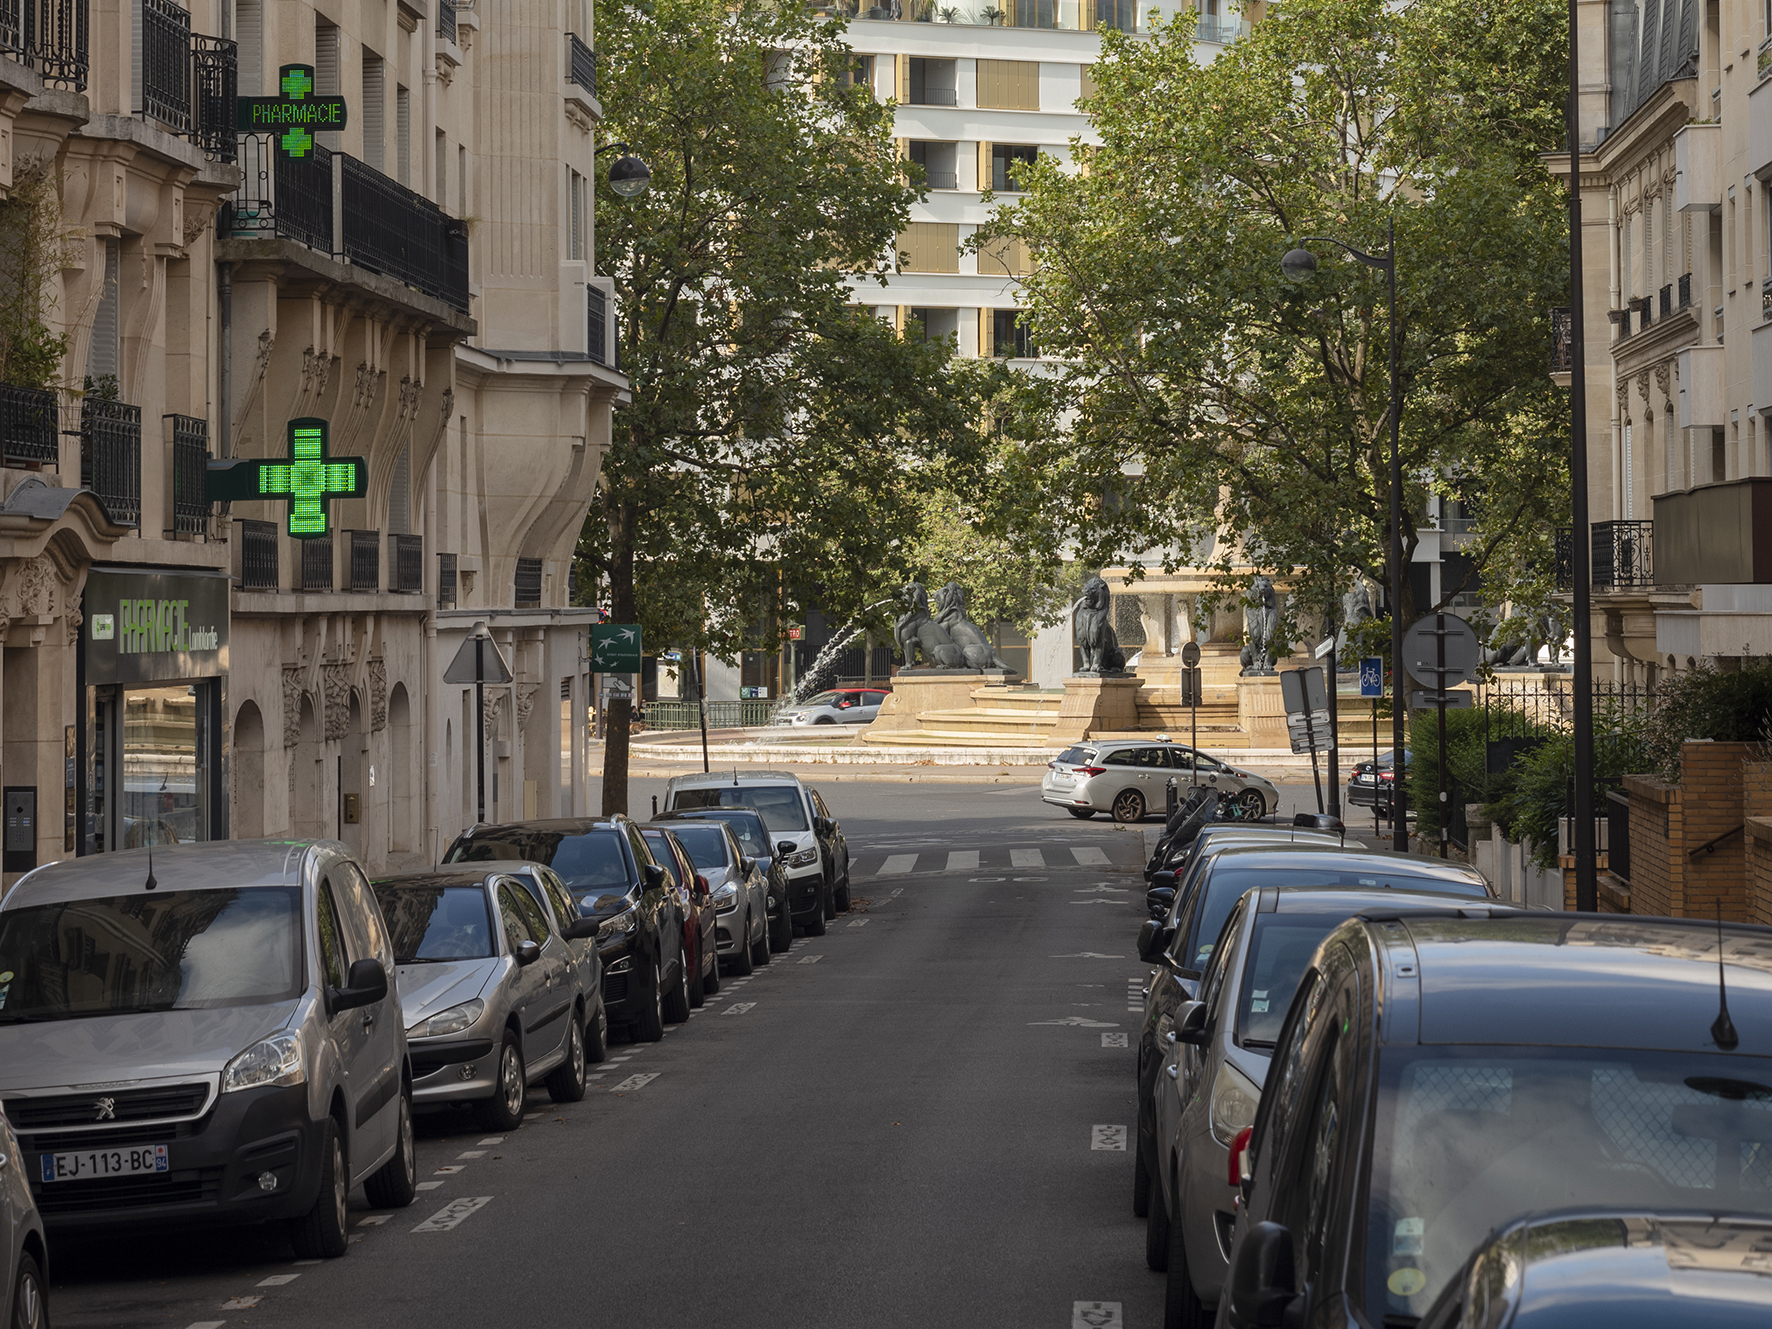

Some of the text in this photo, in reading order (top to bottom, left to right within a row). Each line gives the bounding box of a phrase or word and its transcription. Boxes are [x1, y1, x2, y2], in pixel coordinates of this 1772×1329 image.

[253, 104, 340, 123] PHARMACIE
[119, 599, 189, 654] PHARMACIE
[56, 1150, 153, 1177] EJ-113-BC
[156, 1157, 167, 1168] 94
